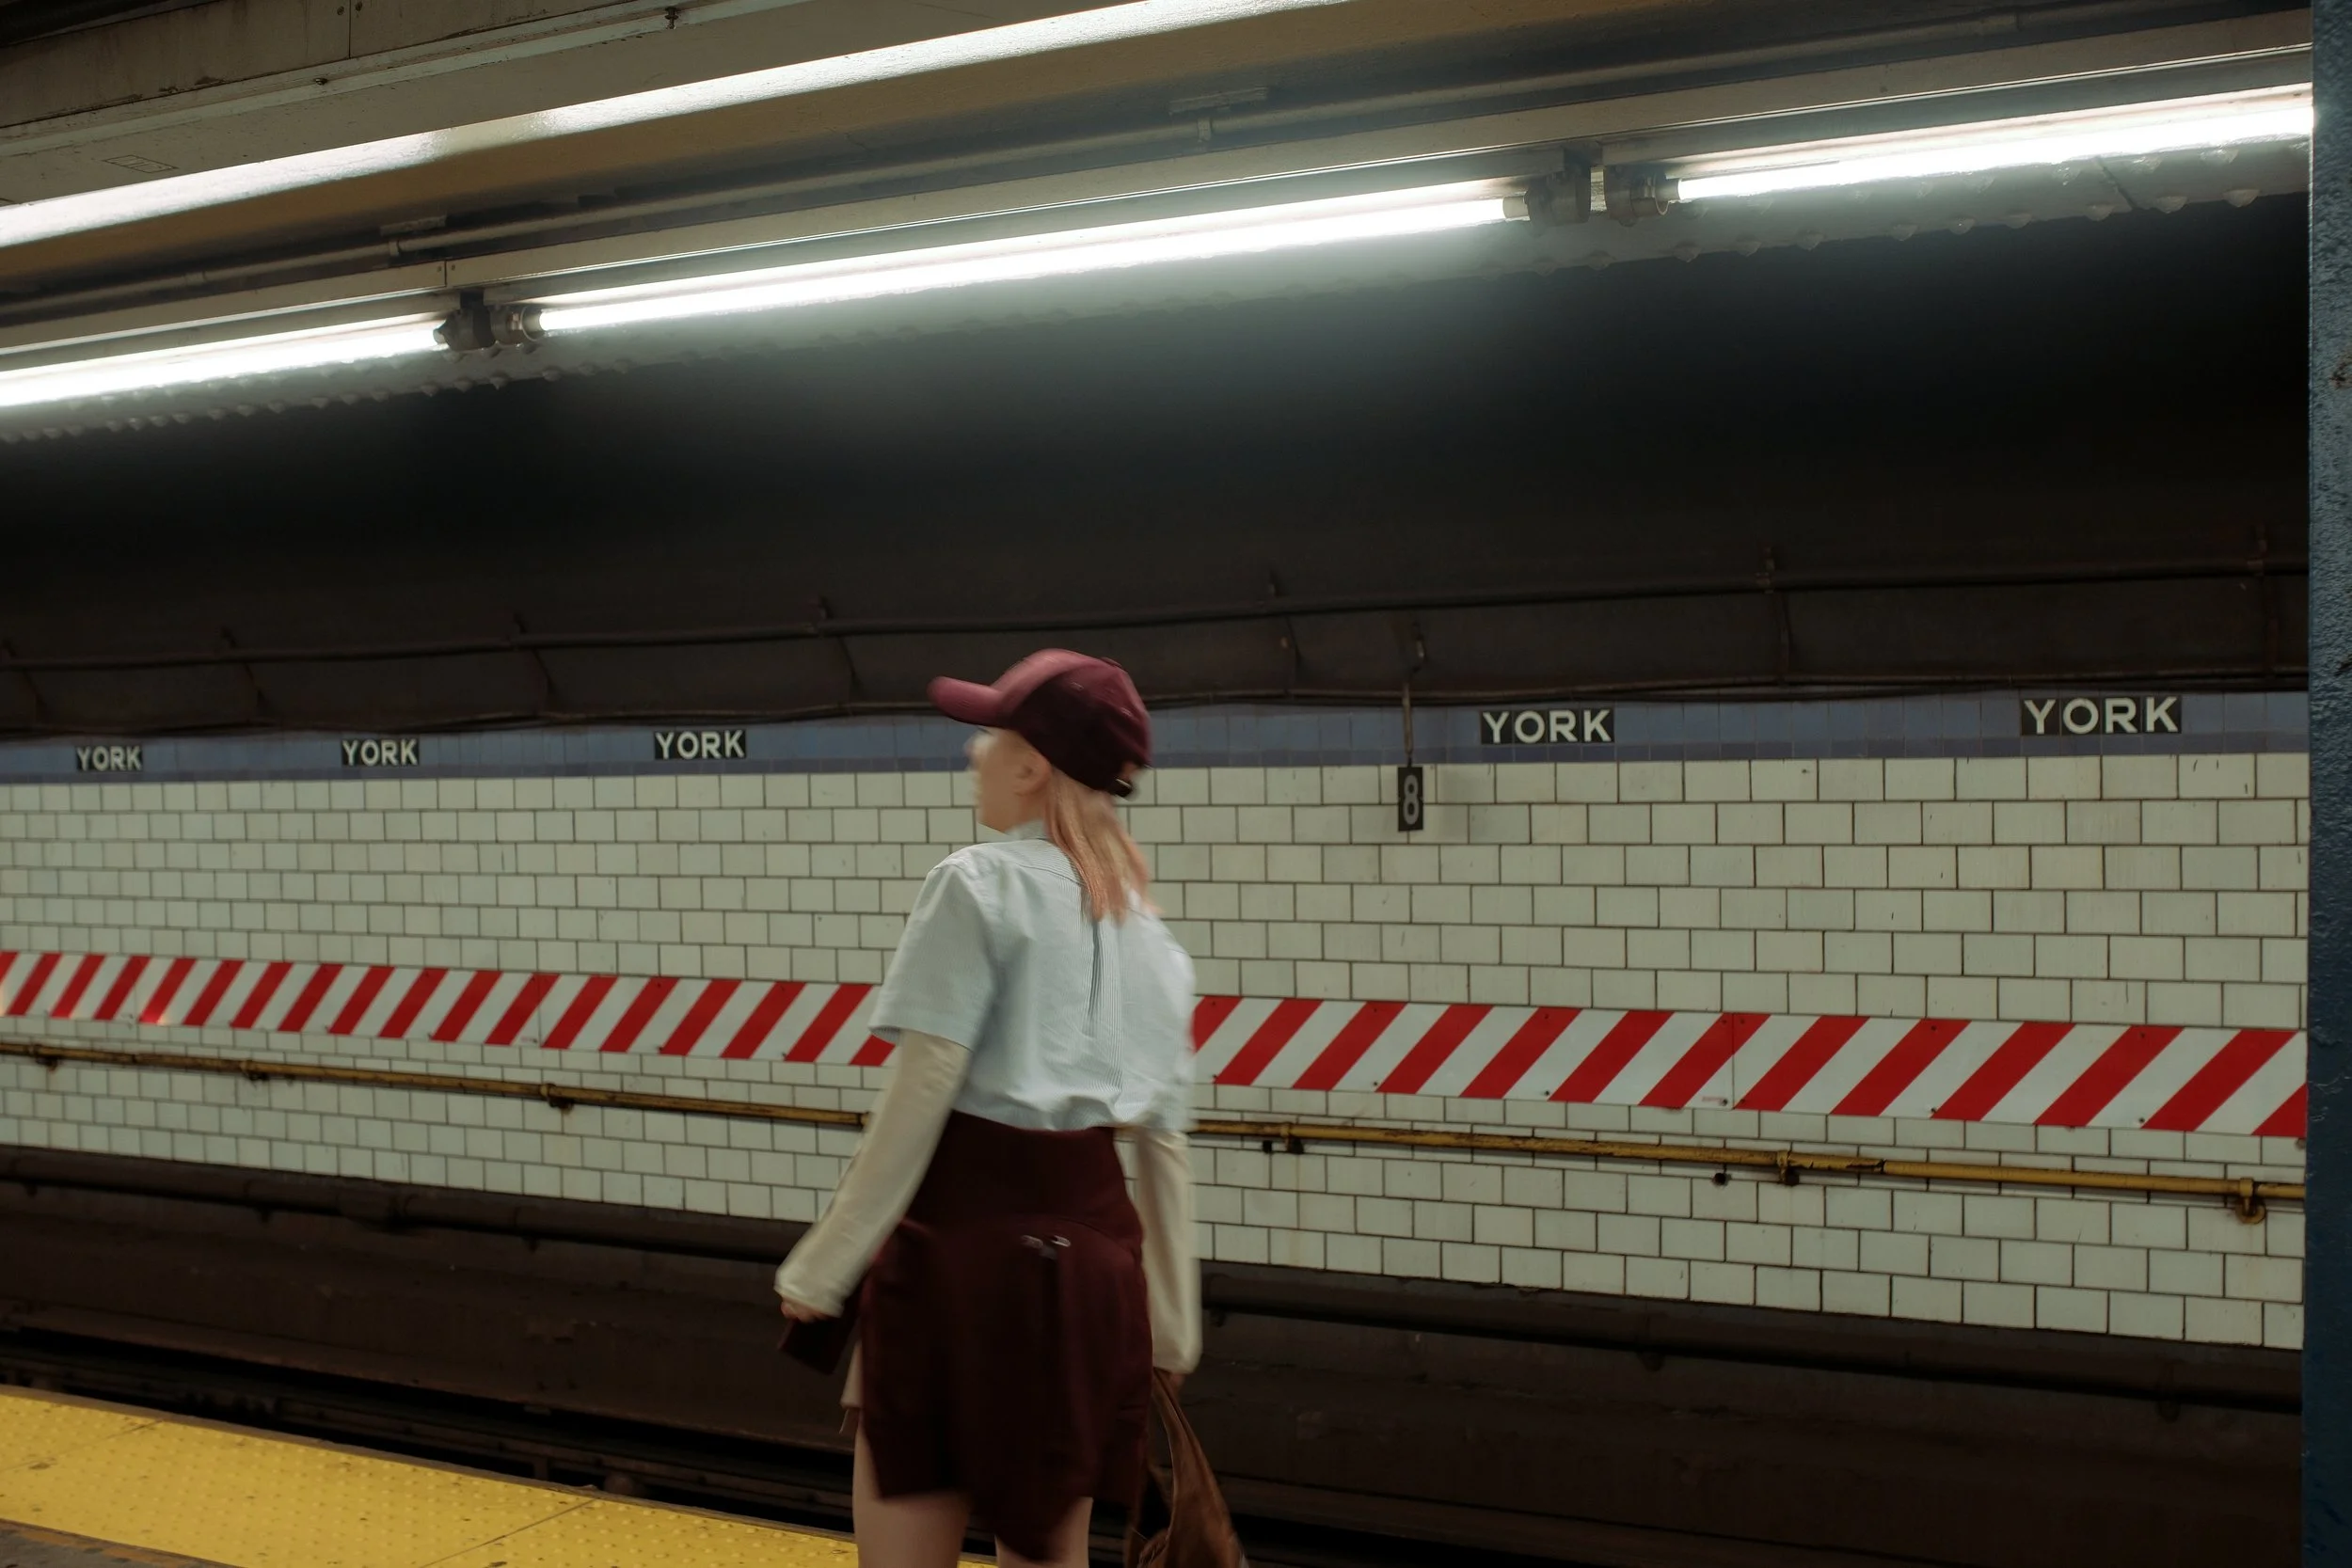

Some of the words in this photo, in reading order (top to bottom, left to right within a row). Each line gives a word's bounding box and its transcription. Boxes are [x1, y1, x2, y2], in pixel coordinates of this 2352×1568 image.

[1482, 709, 1612, 744] YORK
[2024, 696, 2179, 735] YORK
[76, 745, 141, 771] YORK
[342, 738, 418, 767] YORK
[655, 730, 744, 760] YORK
[1403, 774, 1420, 825] 8
